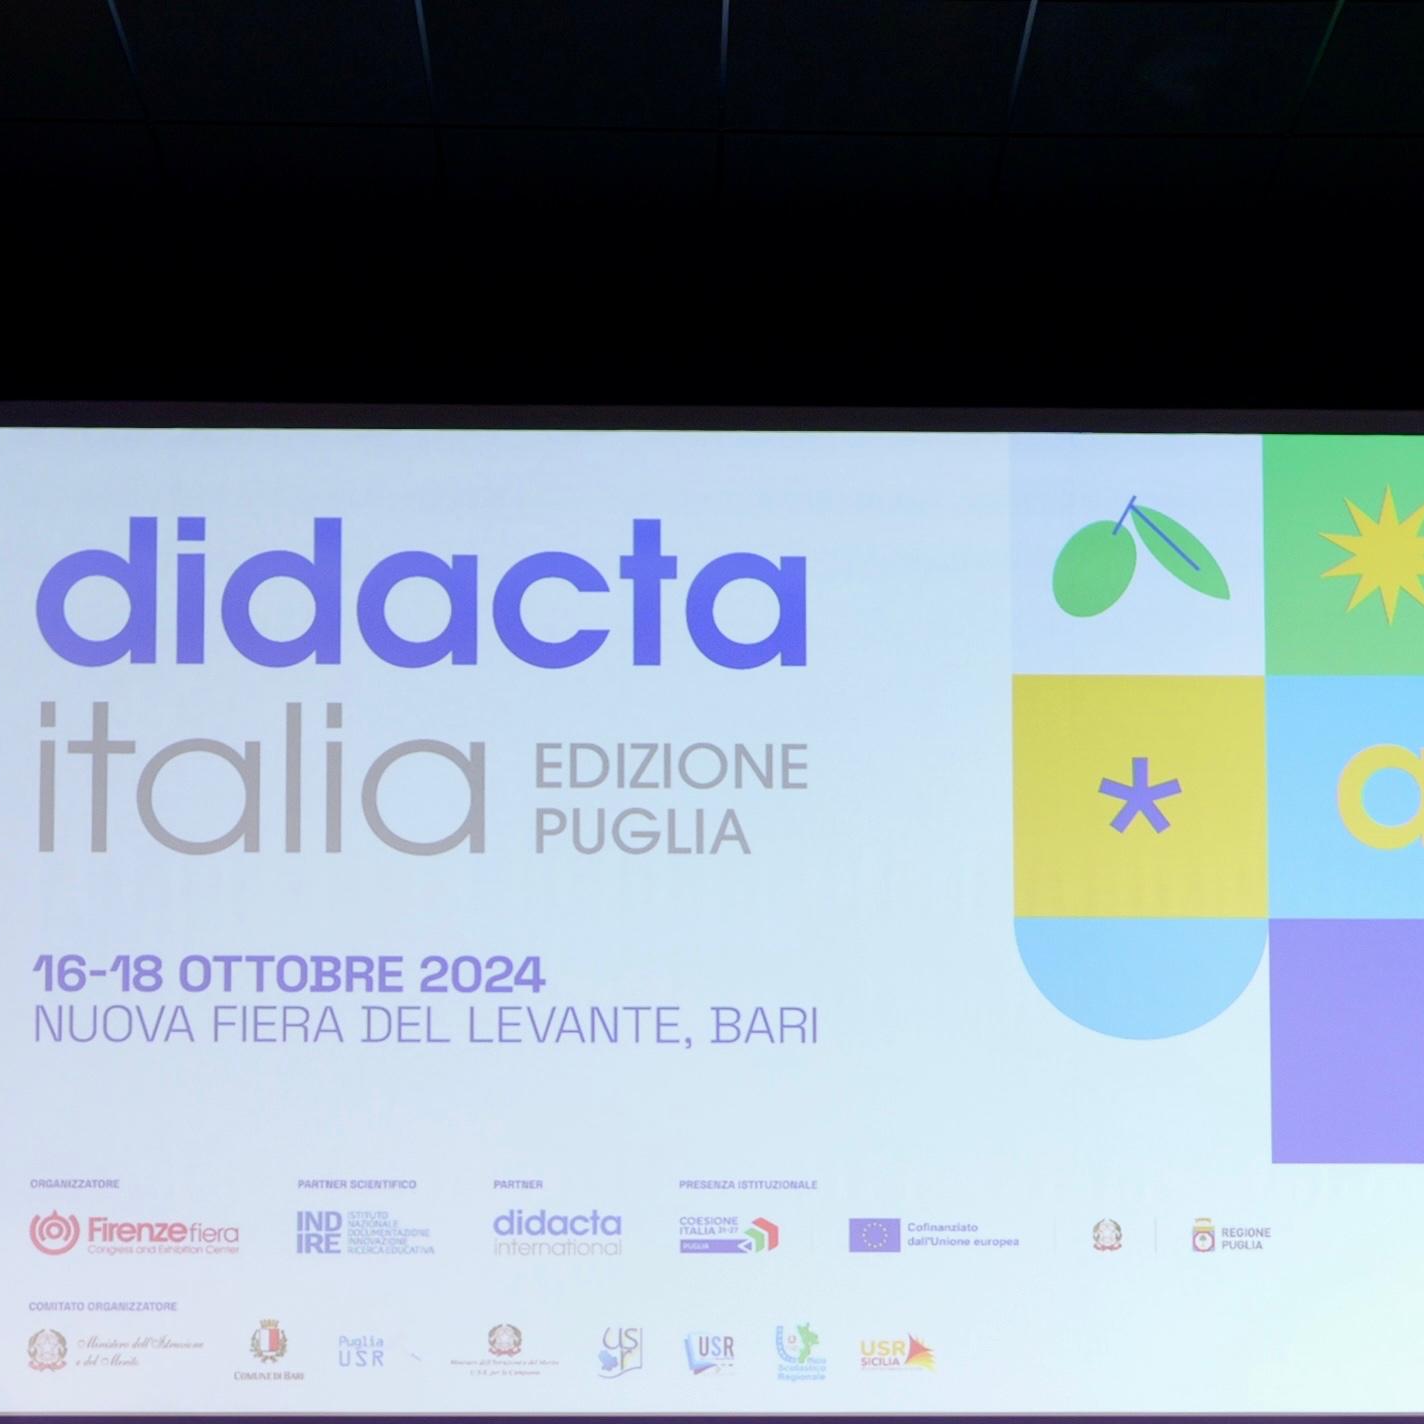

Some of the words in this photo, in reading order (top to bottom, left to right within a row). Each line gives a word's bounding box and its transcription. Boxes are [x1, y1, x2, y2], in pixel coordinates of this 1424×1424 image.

[36, 516, 807, 670] didacta
[535, 742, 809, 789] EDIZIONE
[37, 700, 486, 856] italia
[534, 808, 752, 855] PUGLIA
[32, 953, 163, 993] 16-18
[178, 955, 404, 994] OTTOBRE
[420, 955, 546, 994] 2024
[33, 1004, 195, 1043] NUOVA
[212, 1005, 345, 1044] FIERA
[360, 1005, 452, 1044] DEL
[467, 1005, 692, 1049] LEVANTE,
[710, 1005, 818, 1045] BARI
[30, 1179, 120, 1189] ORGANIZZATORE
[298, 1179, 347, 1190] PARTNER
[350, 1179, 417, 1190] SCIENTIFICO
[493, 1179, 543, 1190] PARTNER
[679, 1180, 735, 1190] PRESENZA
[738, 1180, 818, 1190] ISTITUZIONALE
[296, 1210, 343, 1232] IND
[493, 1209, 622, 1236] didacta
[679, 1216, 739, 1225] COESIONE
[907, 1221, 978, 1233] Cofinanziato
[679, 1226, 715, 1235] ITALIA
[1221, 1227, 1272, 1238] REGIONE
[296, 1233, 342, 1254] IRE
[494, 1238, 622, 1257] international
[907, 1235, 971, 1248] dall'Unione
[973, 1237, 1020, 1249] europea
[1221, 1239, 1263, 1250] PUGLIA
[29, 1302, 85, 1312] COMITATO
[87, 1302, 177, 1312] ORGANIZZATORE
[699, 1336, 734, 1357] USR
[860, 1340, 905, 1356] USR
[338, 1350, 384, 1367] USR
[861, 1357, 900, 1366] SICILIA
